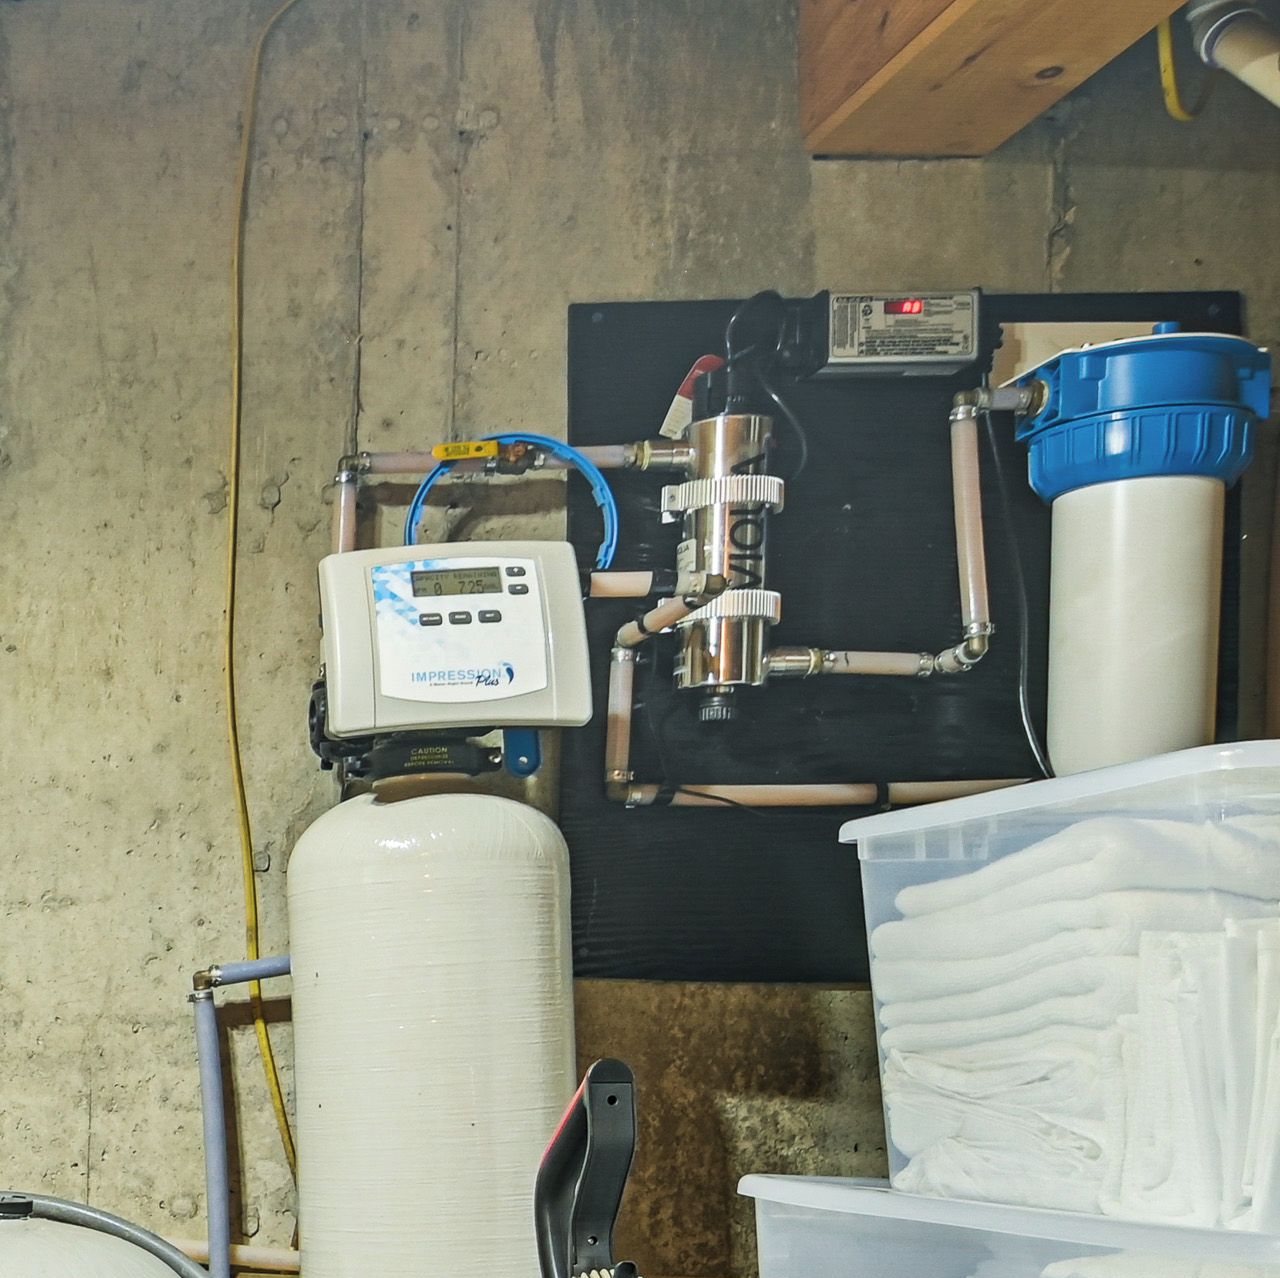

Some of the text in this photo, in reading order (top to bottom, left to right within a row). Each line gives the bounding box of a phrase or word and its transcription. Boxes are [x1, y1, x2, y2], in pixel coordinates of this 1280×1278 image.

[458, 579, 485, 594] 725
[411, 667, 502, 688] IMPRESSION Plus
[410, 746, 448, 755] CAUTION
